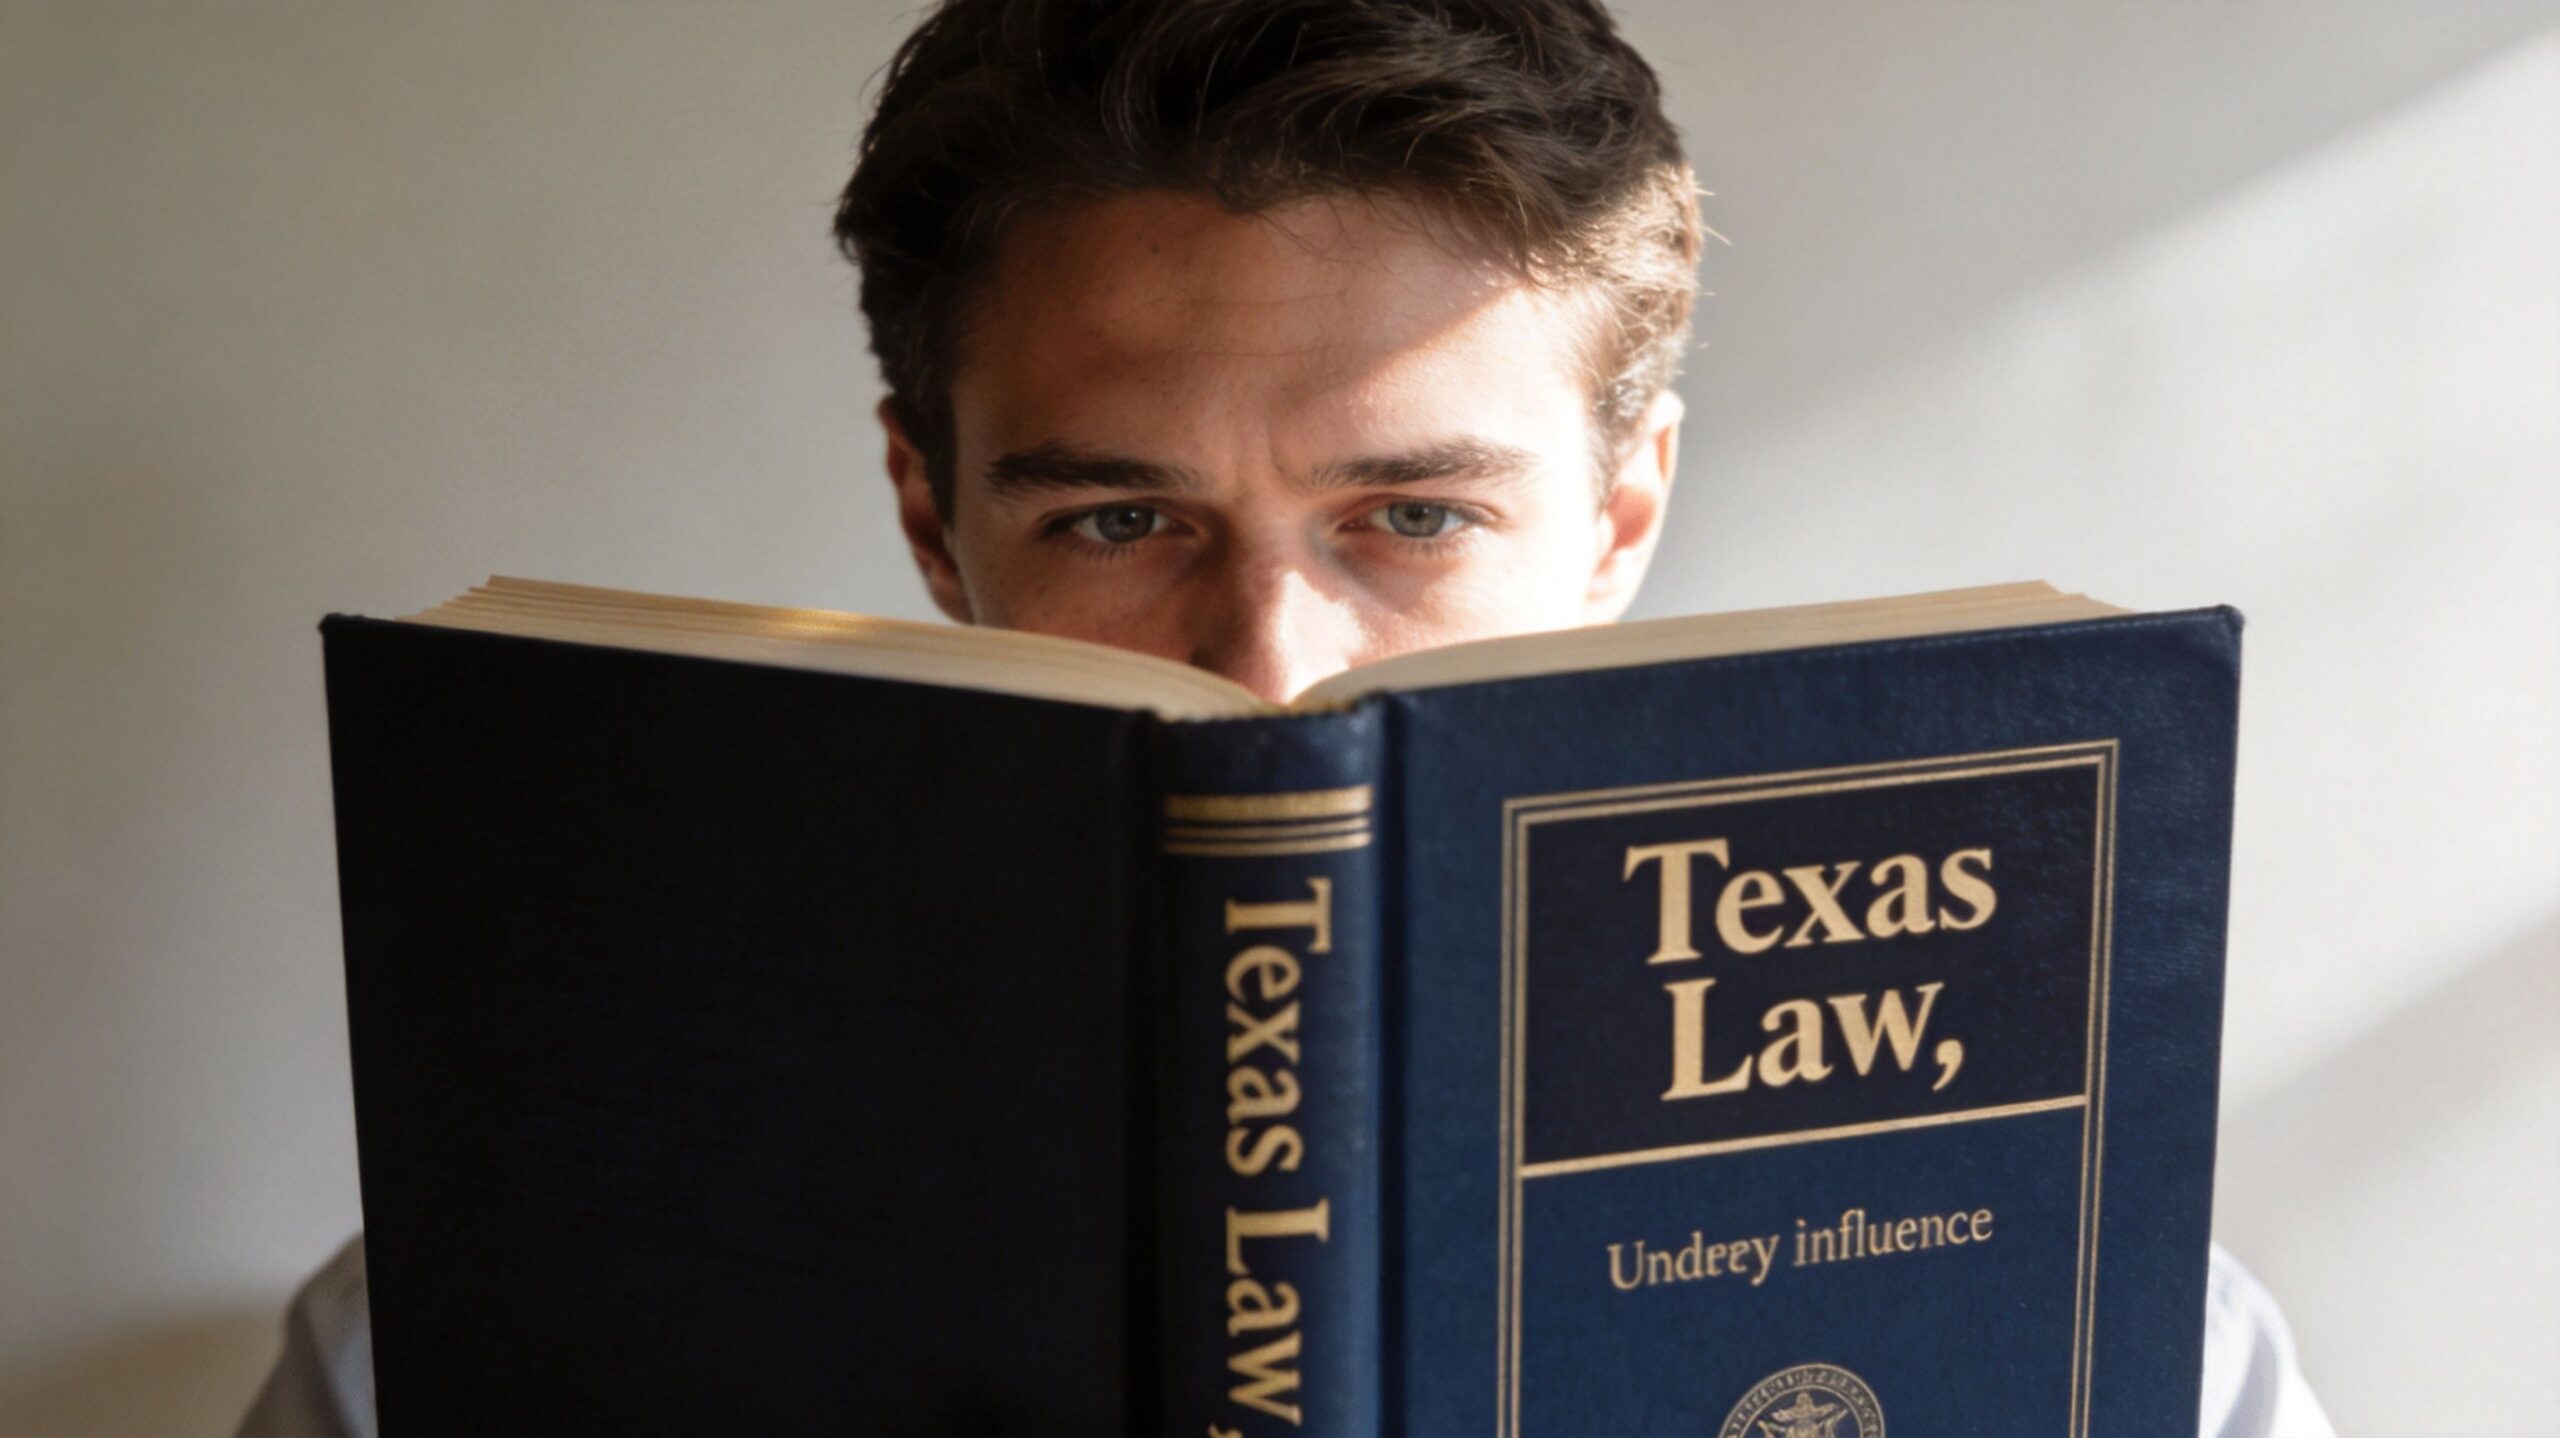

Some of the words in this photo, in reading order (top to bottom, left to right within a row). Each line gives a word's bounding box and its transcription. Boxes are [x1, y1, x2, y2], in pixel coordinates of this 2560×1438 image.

[1622, 836, 1998, 966] Texas
[1223, 876, 1333, 1177] Texas
[1661, 976, 1965, 1102] Law,
[1793, 1207, 1994, 1267] influence
